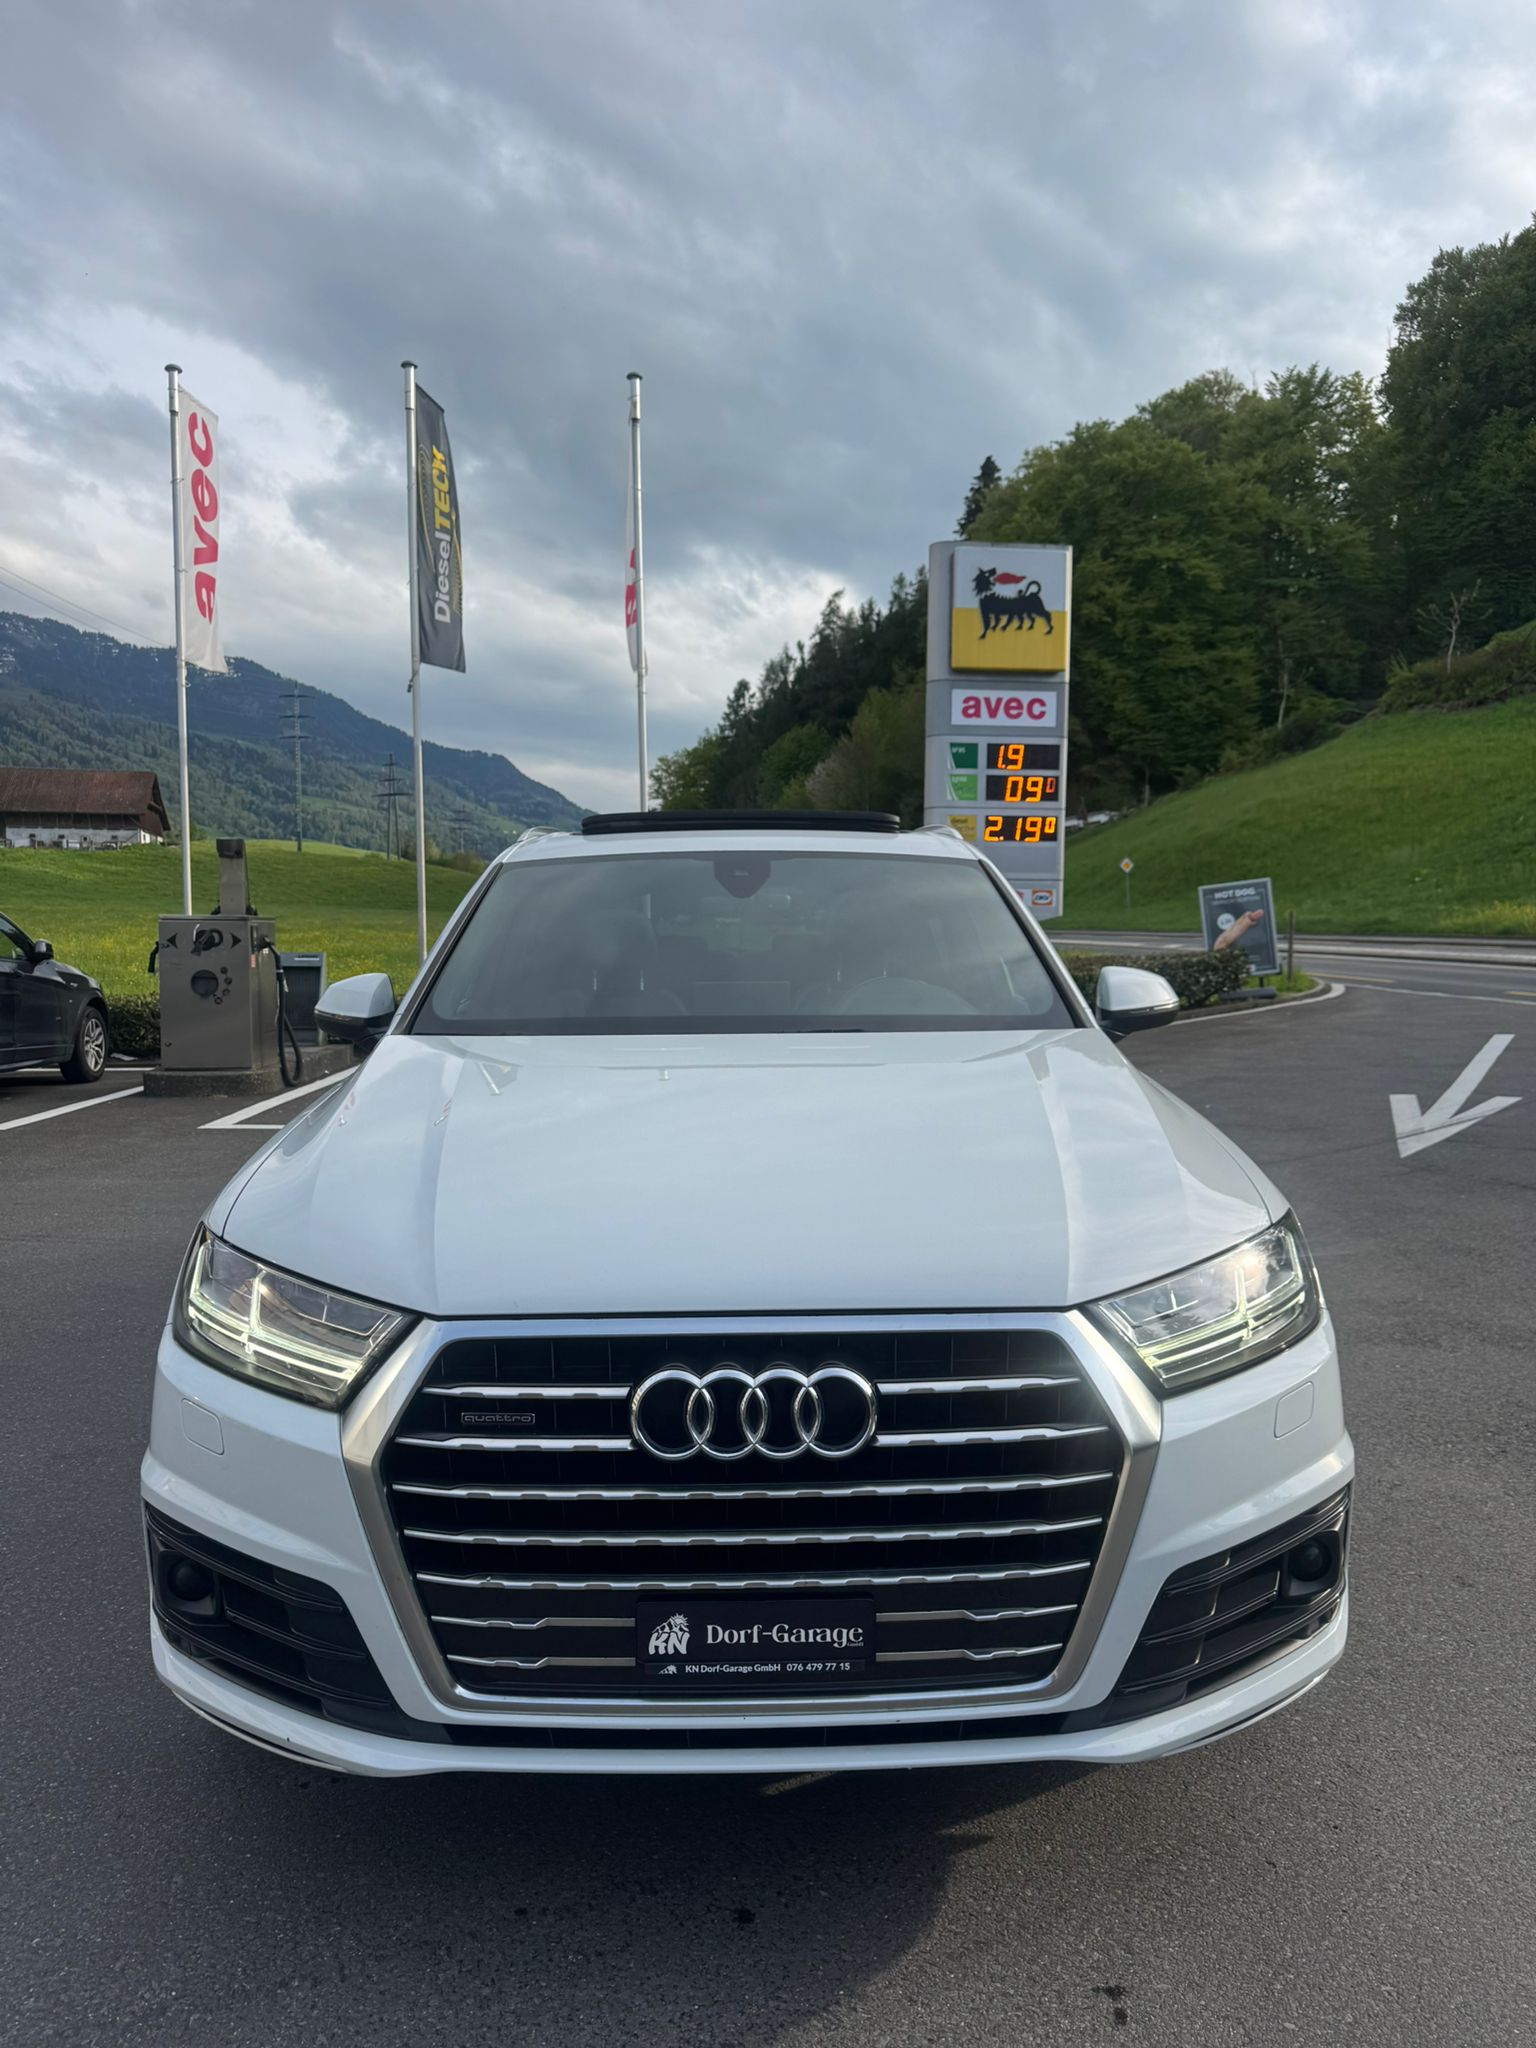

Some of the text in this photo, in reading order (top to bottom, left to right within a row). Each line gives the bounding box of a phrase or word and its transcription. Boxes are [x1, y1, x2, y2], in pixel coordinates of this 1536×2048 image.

[188, 412, 218, 624] avec
[961, 696, 1047, 720] avec
[1214, 887, 1256, 900] HOT DOG
[464, 1413, 531, 1423] quattro
[649, 1631, 690, 1655] KN
[706, 1623, 863, 1648] Dorf-Garage
[685, 1662, 850, 1674] KN Dorf-Garage GmbH 076 479 77 15
